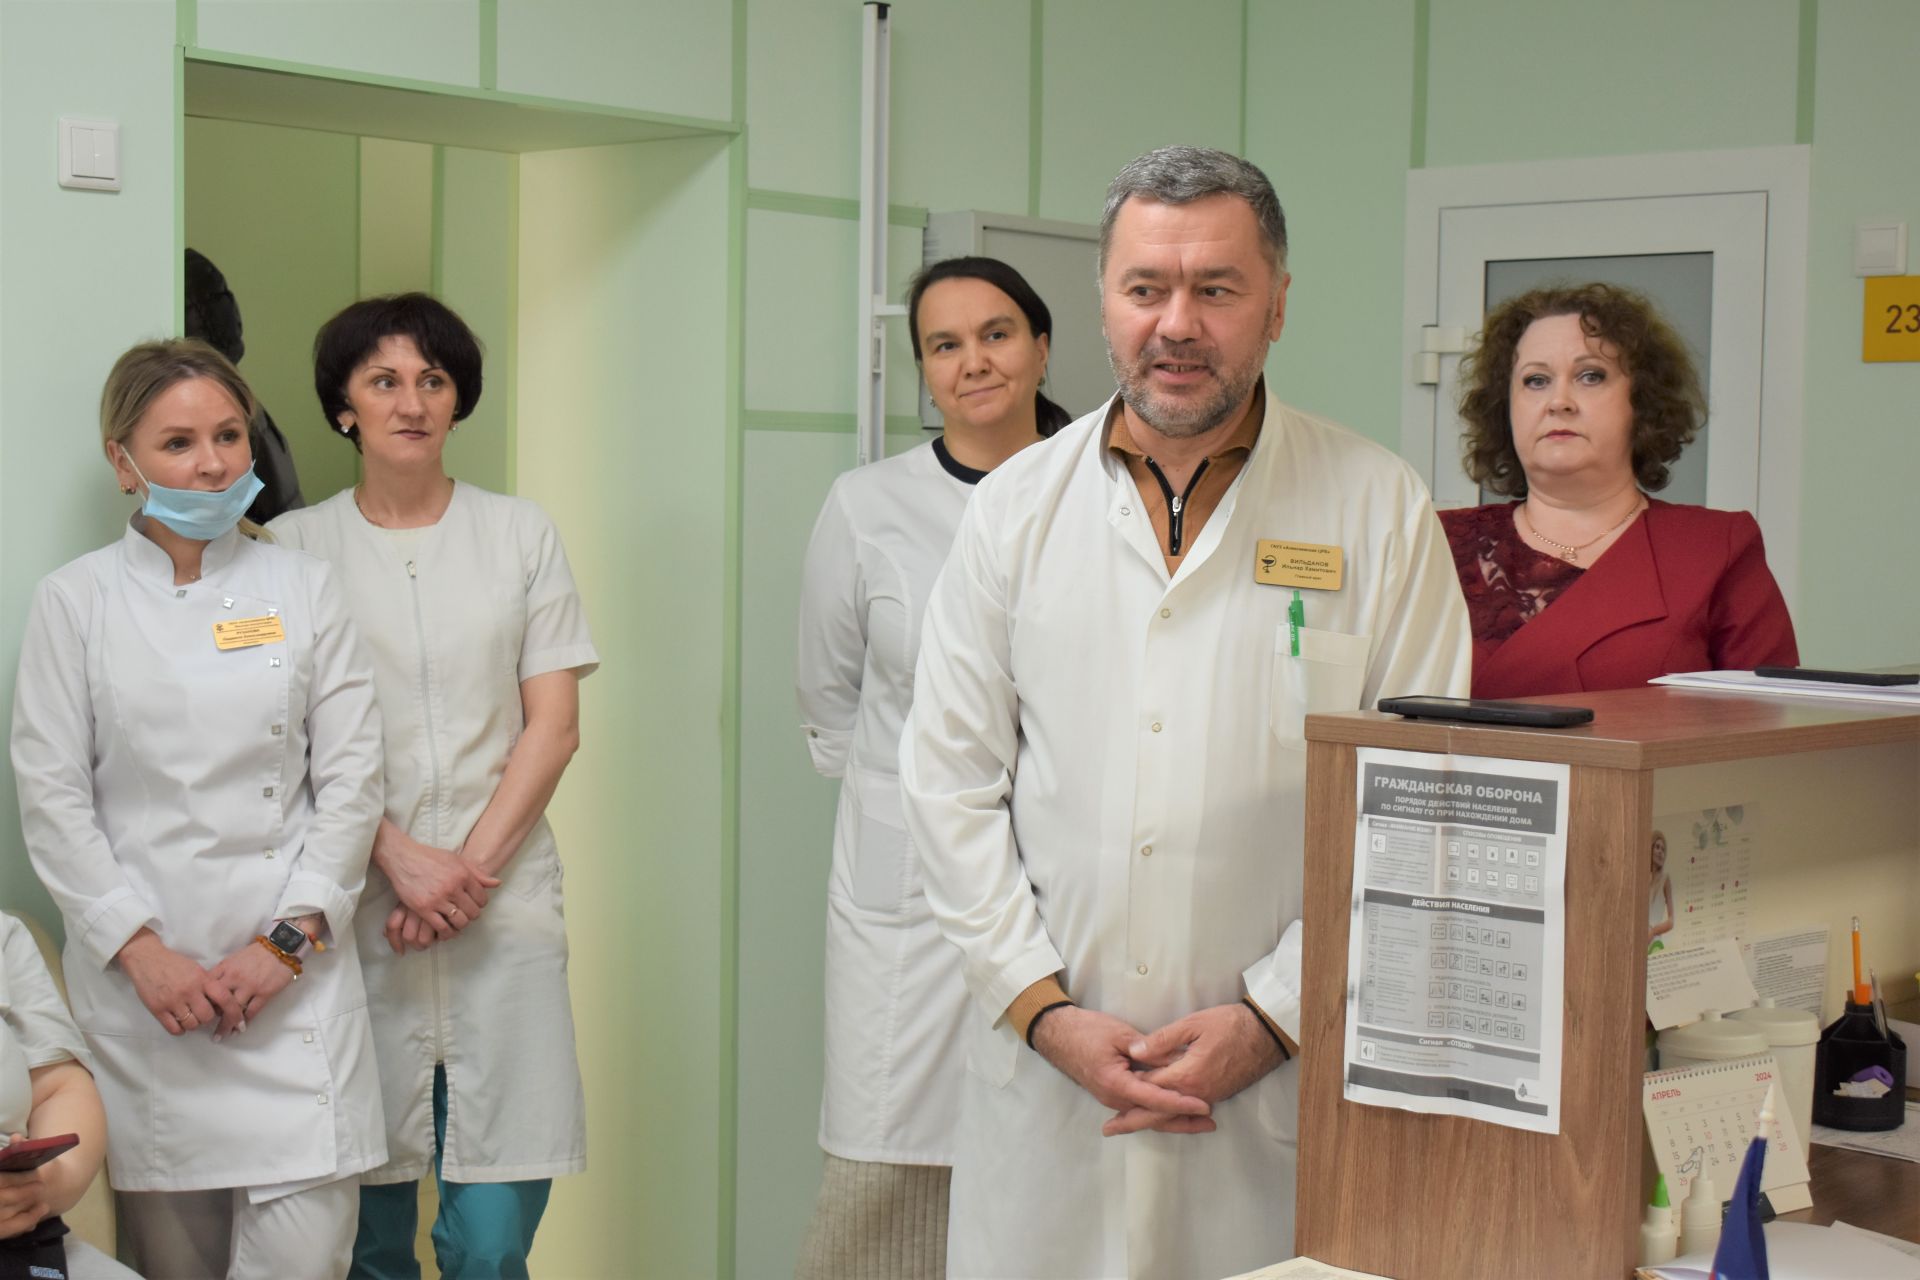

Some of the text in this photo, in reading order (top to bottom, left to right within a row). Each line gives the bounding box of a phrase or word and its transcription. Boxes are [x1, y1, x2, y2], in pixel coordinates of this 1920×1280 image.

[1289, 558, 1329, 568] ВИЛЬДАНОВ
[1373, 775, 1543, 805] ГРАЖДАНСКАЯ ОБОРОНА
[1394, 795, 1518, 815] ПОРЯДОК ДЕЙСТВИЙ НАСЕЛЕНИЯ
[1380, 802, 1533, 826] ПО СИГНАЛУ ГО ПРИ НАХОЖДЕНИИ ДОМА
[1411, 898, 1490, 914] ДЕЙСТВИЯ НАСЕЛЕНИЯ
[1418, 1038, 1444, 1047] Сигнал
[1754, 1071, 1773, 1082] 2024
[1651, 1088, 1682, 1101] АПРЕЛЬ
